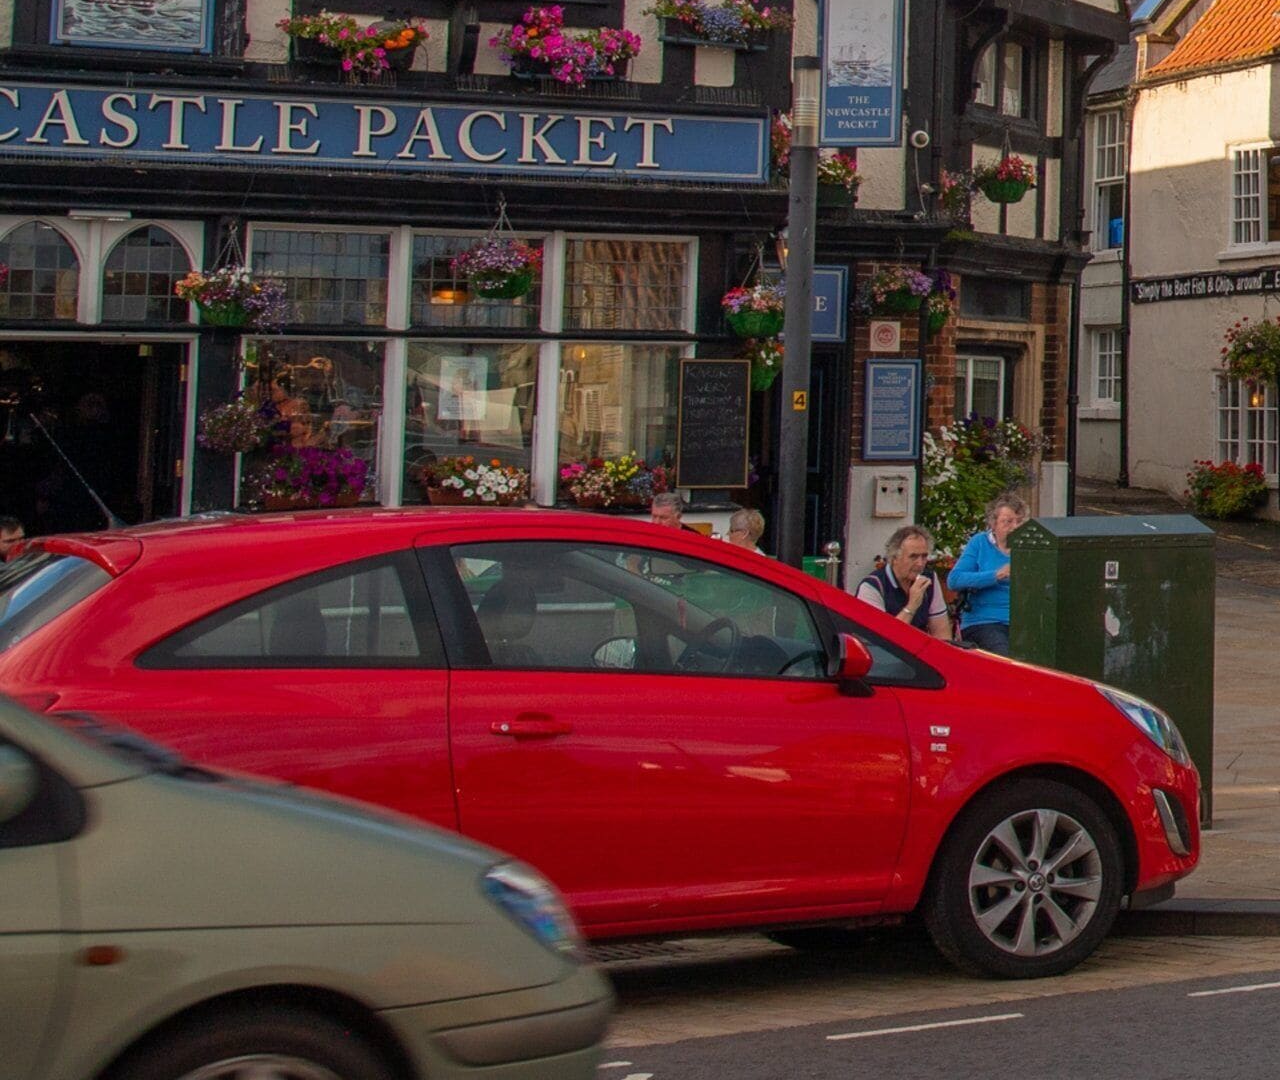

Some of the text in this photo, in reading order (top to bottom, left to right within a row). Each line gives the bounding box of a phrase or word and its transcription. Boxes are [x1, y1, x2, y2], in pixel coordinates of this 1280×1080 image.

[848, 95, 870, 105] THE
[826, 107, 891, 117] NEWCASTLE
[837, 120, 879, 129] PACKET
[353, 106, 674, 169] PACKET
[1162, 283, 1173, 296] the
[1174, 280, 1190, 296] Best
[1192, 278, 1206, 294] Fish
[1215, 276, 1234, 294] Chips
[794, 394, 805, 407] 4
